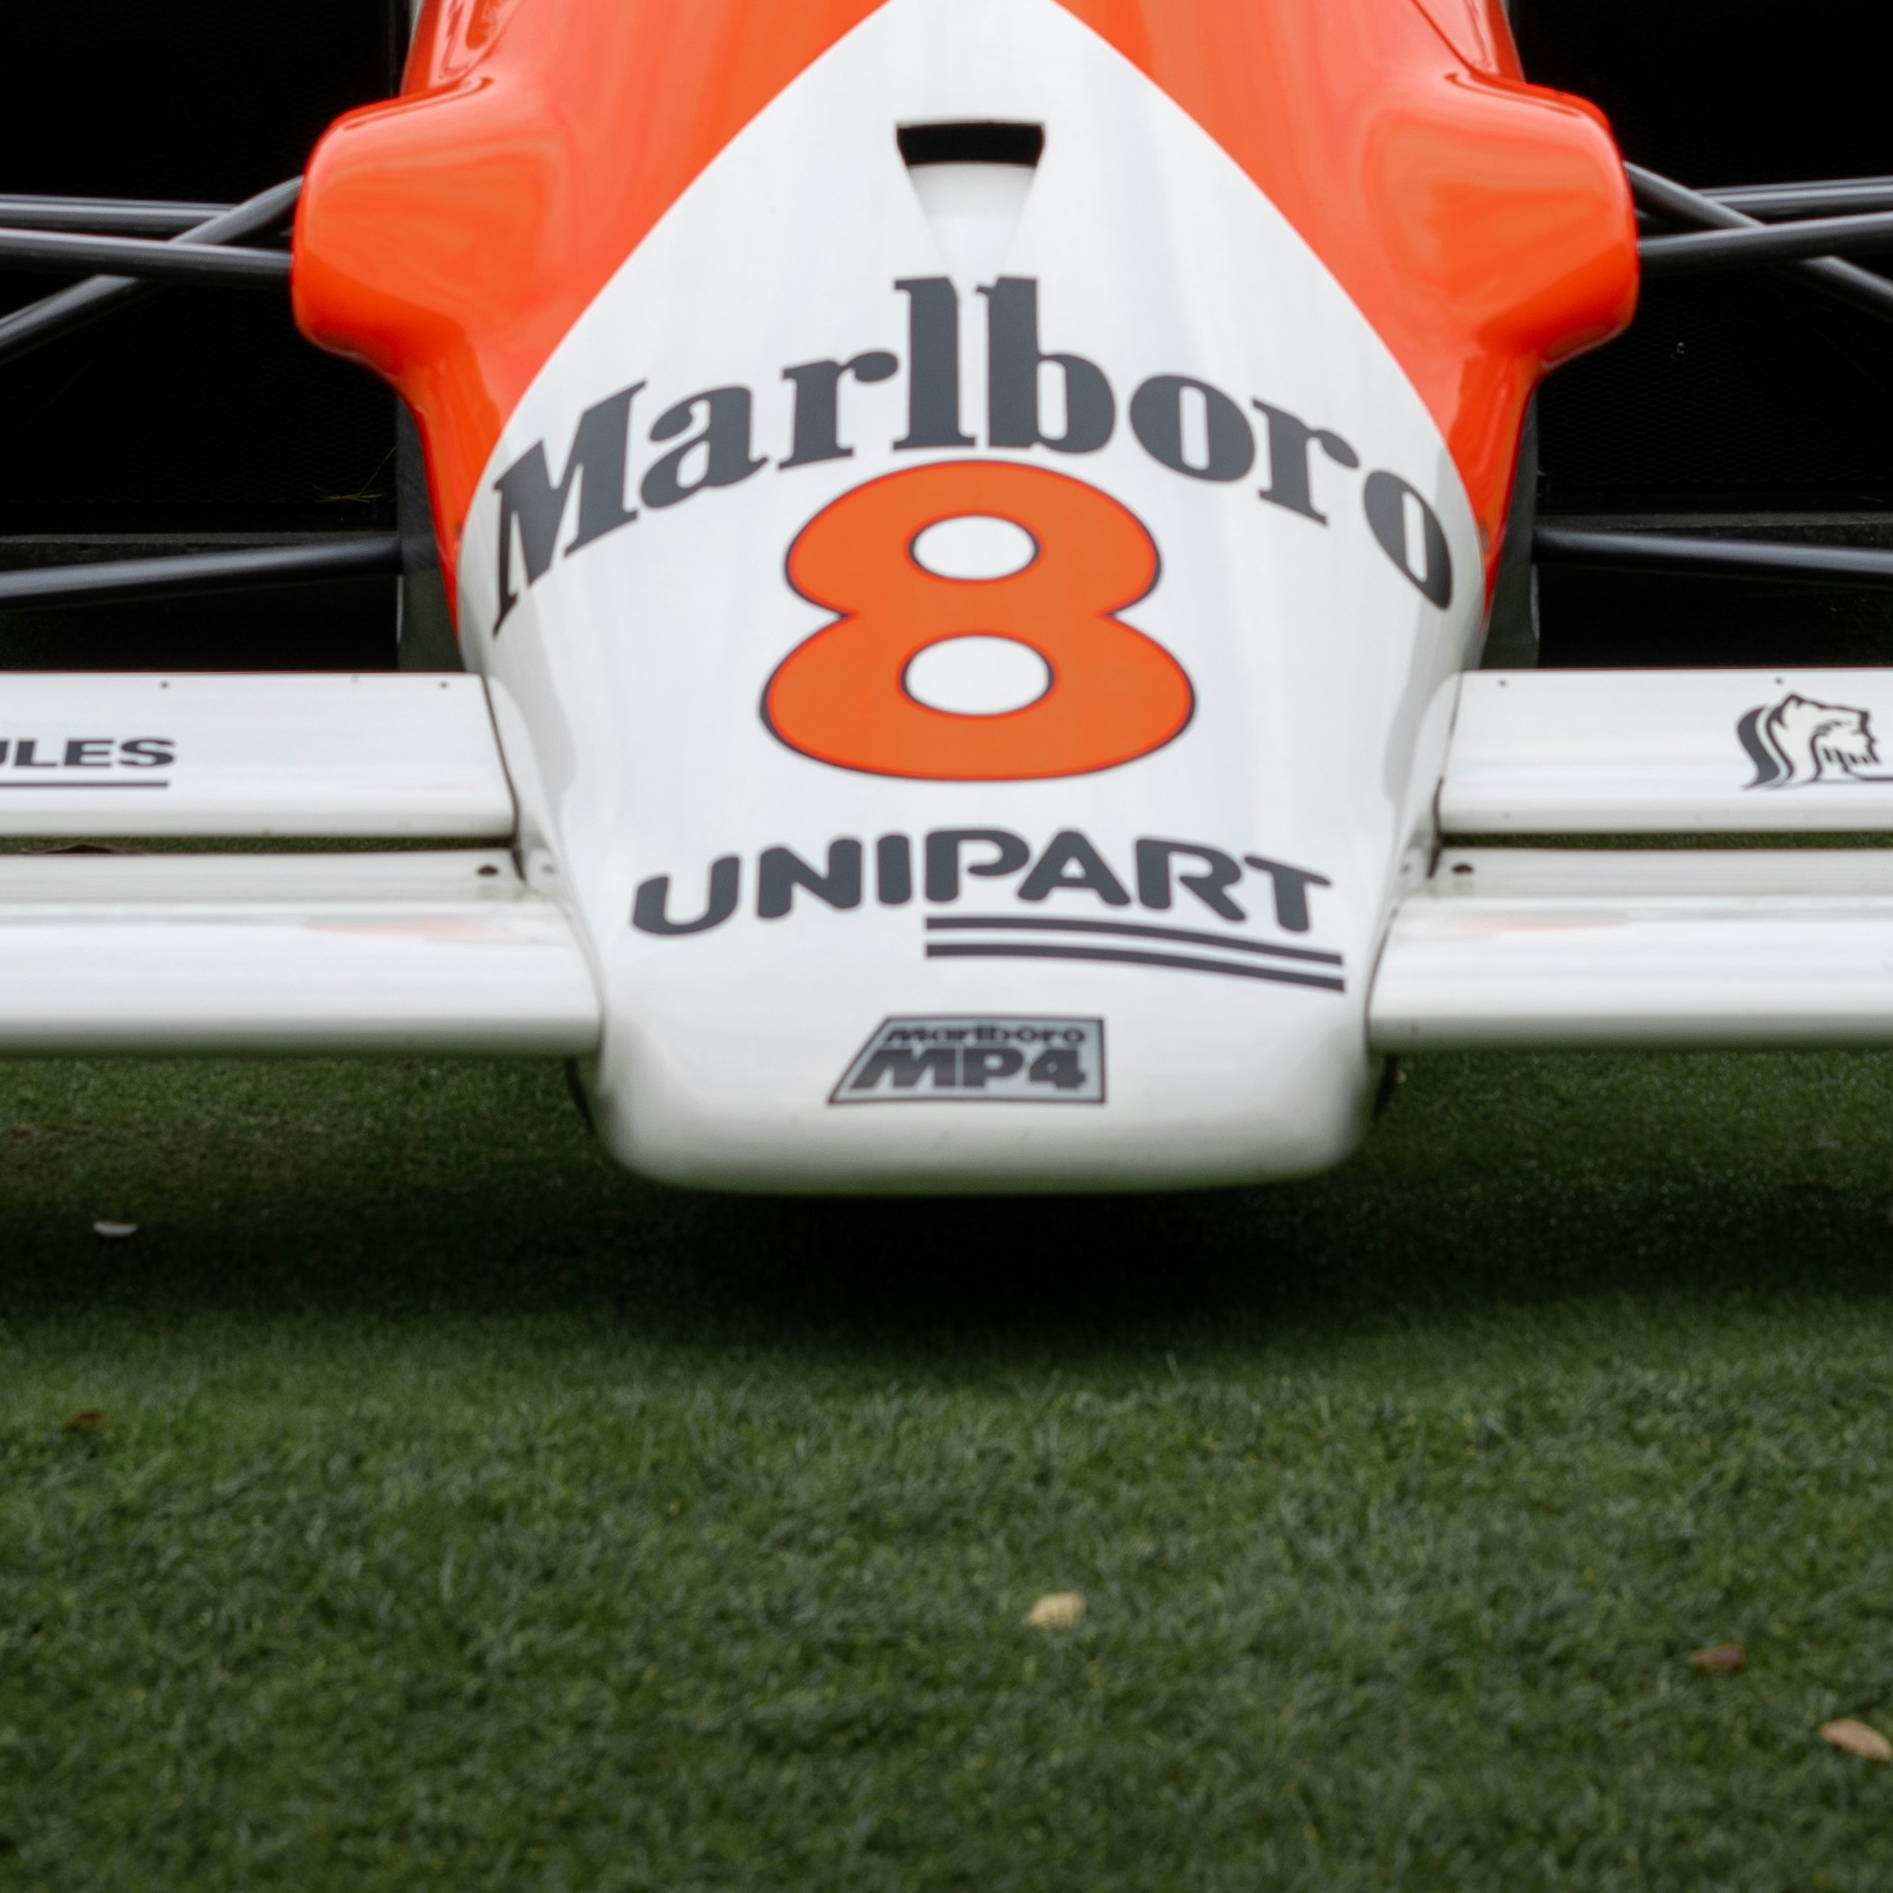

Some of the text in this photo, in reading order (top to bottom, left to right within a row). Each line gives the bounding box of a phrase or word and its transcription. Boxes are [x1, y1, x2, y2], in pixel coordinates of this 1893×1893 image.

[490, 275, 1453, 639] Marlboro
[758, 457, 1196, 783] 8
[629, 827, 1334, 937] UNIPART
[850, 1047, 1087, 1090] MP4
